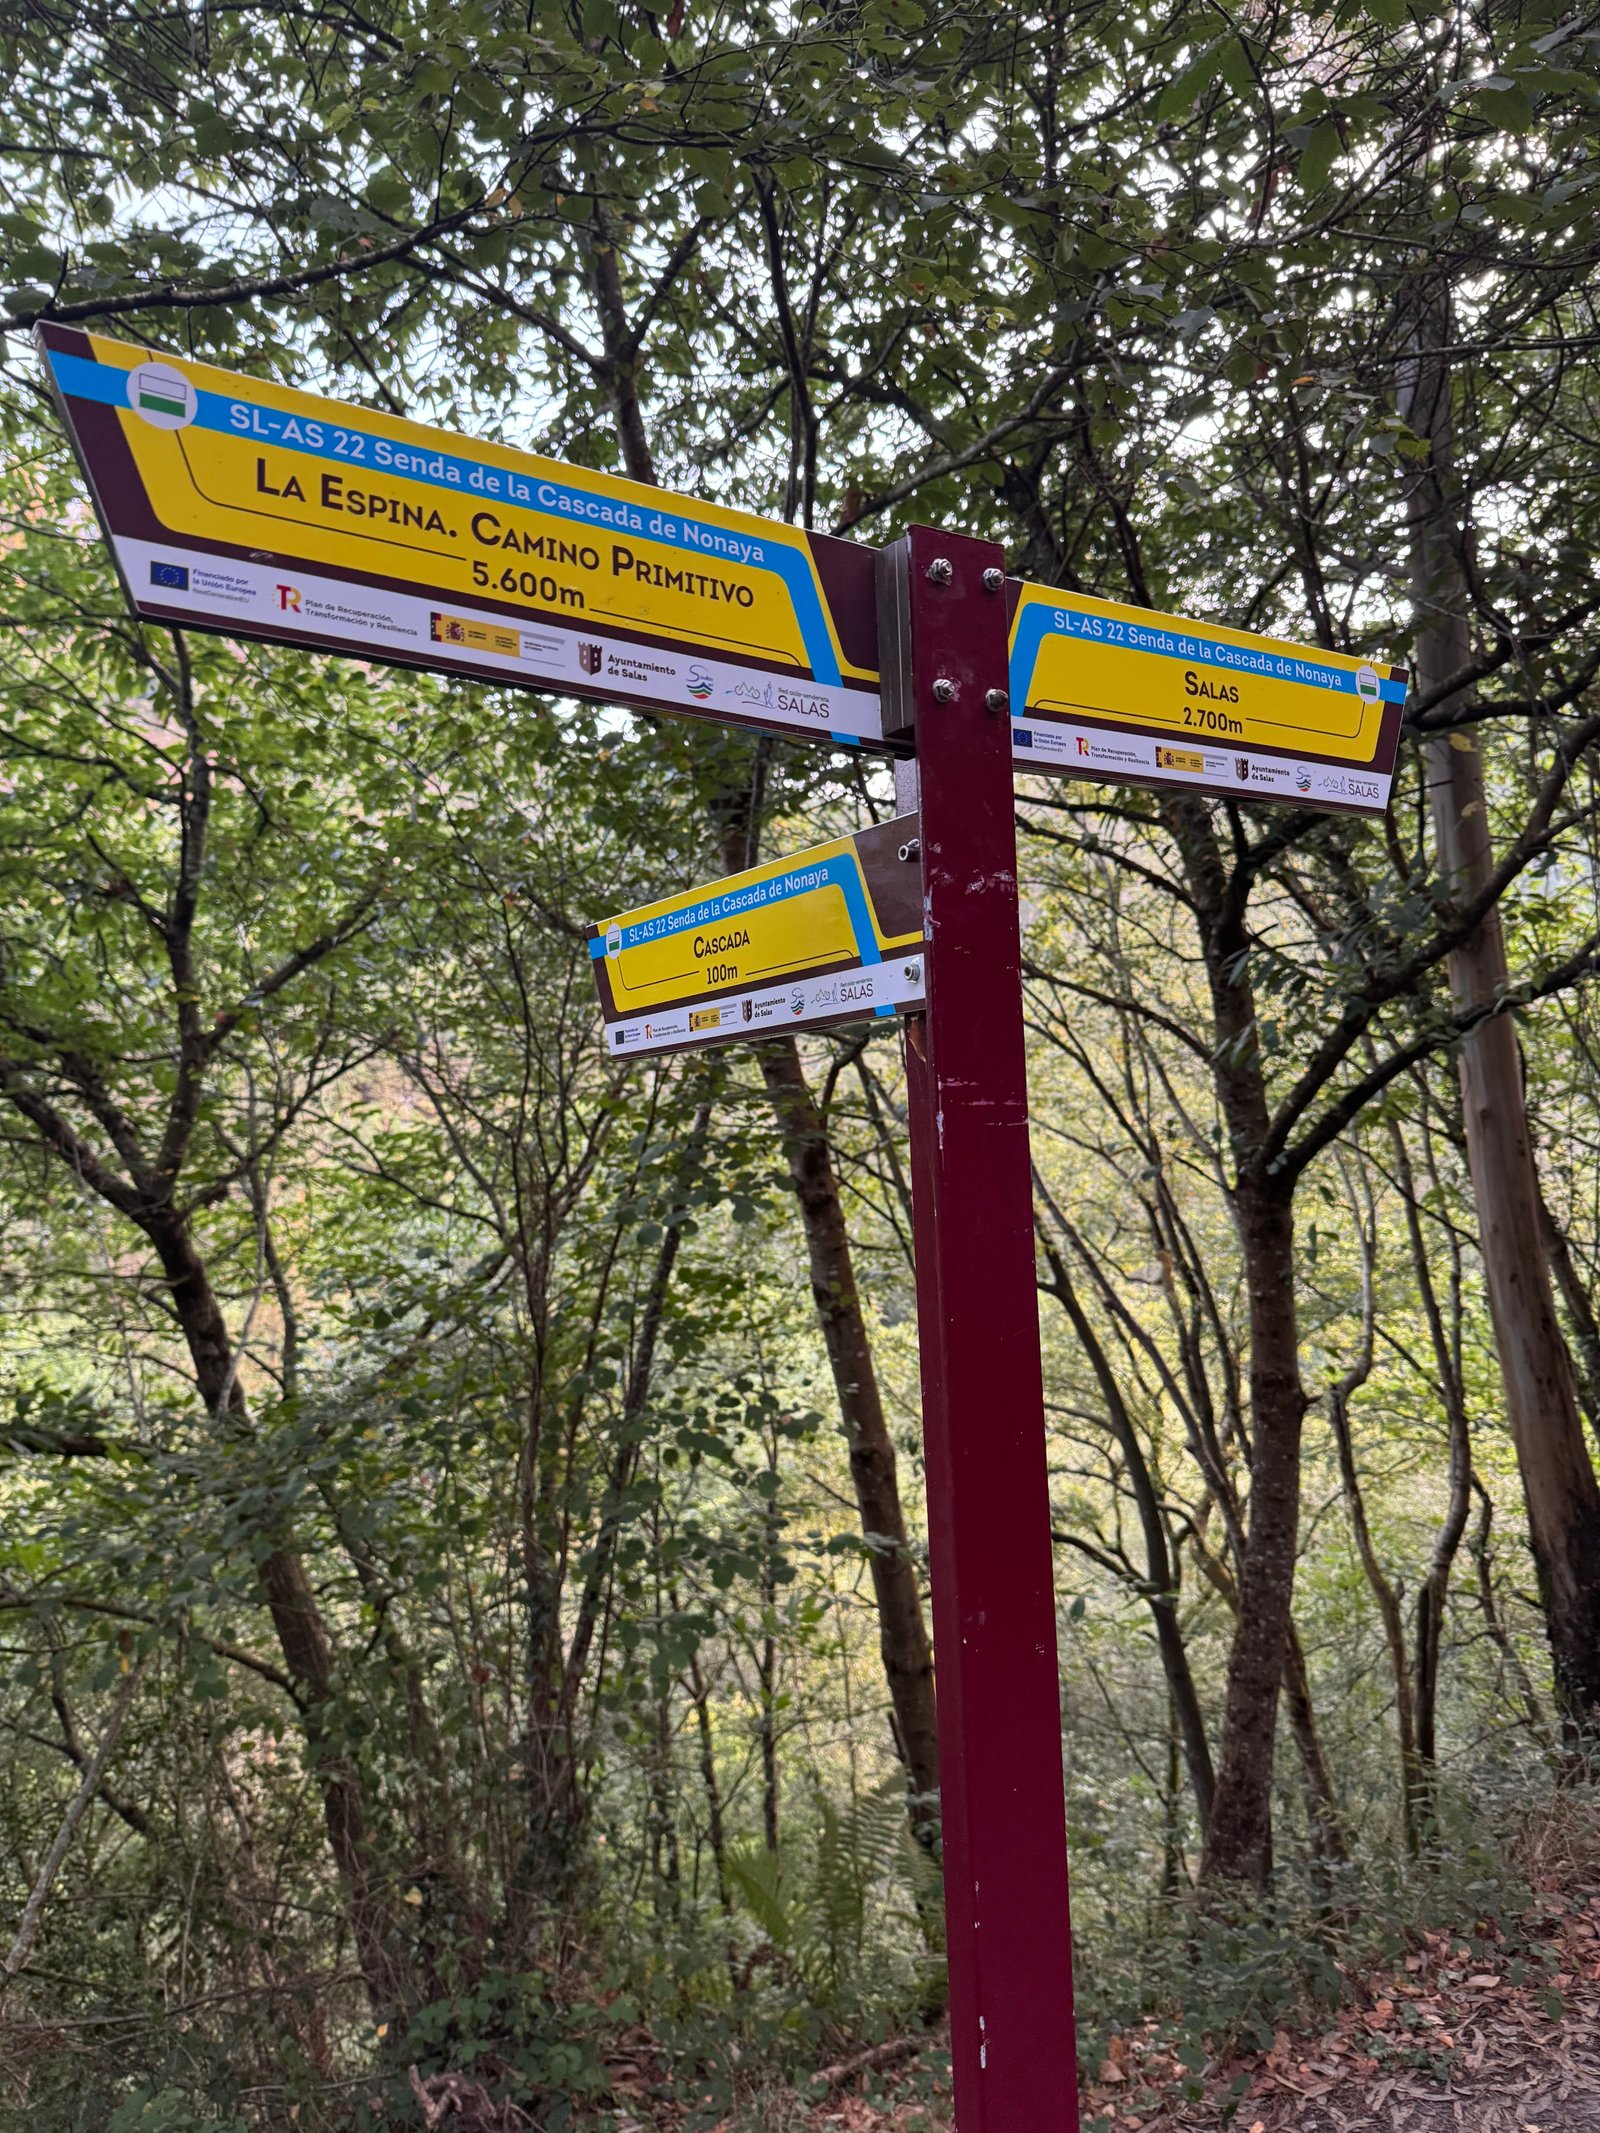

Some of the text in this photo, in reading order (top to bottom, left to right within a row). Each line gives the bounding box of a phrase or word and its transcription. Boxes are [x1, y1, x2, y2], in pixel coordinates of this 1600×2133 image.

[230, 403, 765, 564] SL-AS 22 Senda de la Cascada de Nonaya
[192, 568, 249, 585] Financiado por
[192, 577, 257, 596] la Unión Europea
[472, 560, 585, 609] 5.600m
[305, 599, 394, 623] Plan de Recuperación,
[306, 608, 418, 637] Transformación y Resiliencia
[1054, 610, 1342, 689] SL-AS 22 Senda de la Cascada de Nonaya
[608, 654, 676, 676] Ayuntamiento
[608, 666, 648, 682] de Salas
[778, 686, 788, 695] Red
[778, 694, 830, 719] SALAS
[1183, 706, 1243, 734] 2.700m
[1252, 764, 1291, 776] Ayuntamiento
[1252, 772, 1275, 783] de Salas
[1348, 783, 1380, 799] SALAS
[629, 868, 829, 942] SL-AS 22 Senda de la Cascada de Nonaya
[706, 964, 738, 985] 100m
[754, 997, 786, 1009] Ayuntamiento
[840, 983, 874, 1002] SALAS
